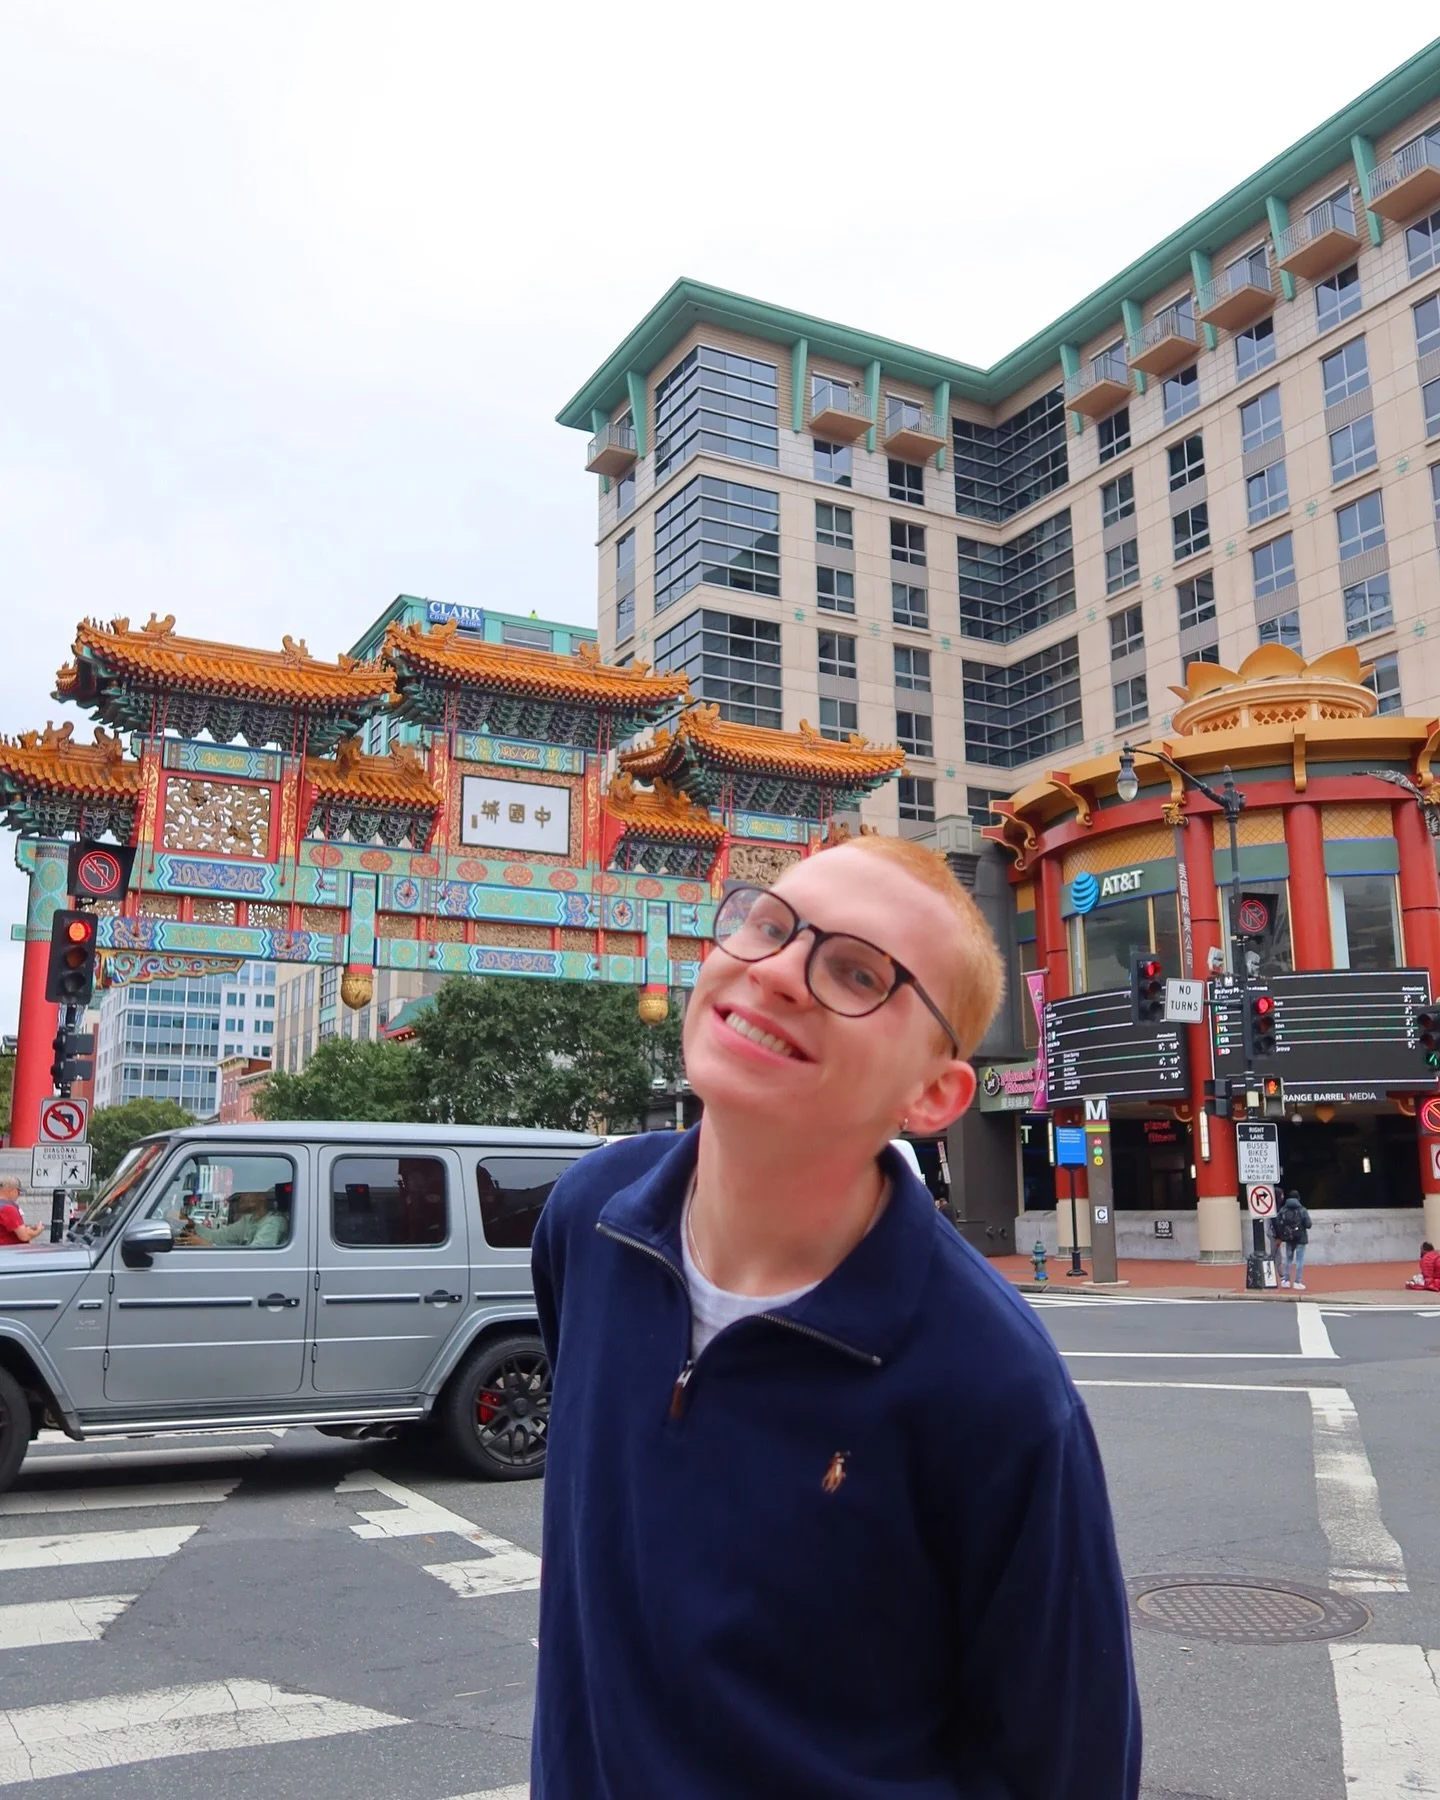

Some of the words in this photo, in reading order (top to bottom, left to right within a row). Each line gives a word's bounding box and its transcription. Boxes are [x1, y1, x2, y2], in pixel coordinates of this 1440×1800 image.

[430, 602, 480, 621] CLARK
[1102, 869, 1143, 897] AT&T
[1179, 985, 1191, 995] NO
[1170, 1000, 1198, 1012] TURNS
[1283, 1093, 1312, 1101] RANGE
[1314, 1092, 1345, 1101] BARREL
[1349, 1092, 1377, 1100] MEDIA
[1085, 1100, 1107, 1120] M
[1097, 1209, 1107, 1220] C
